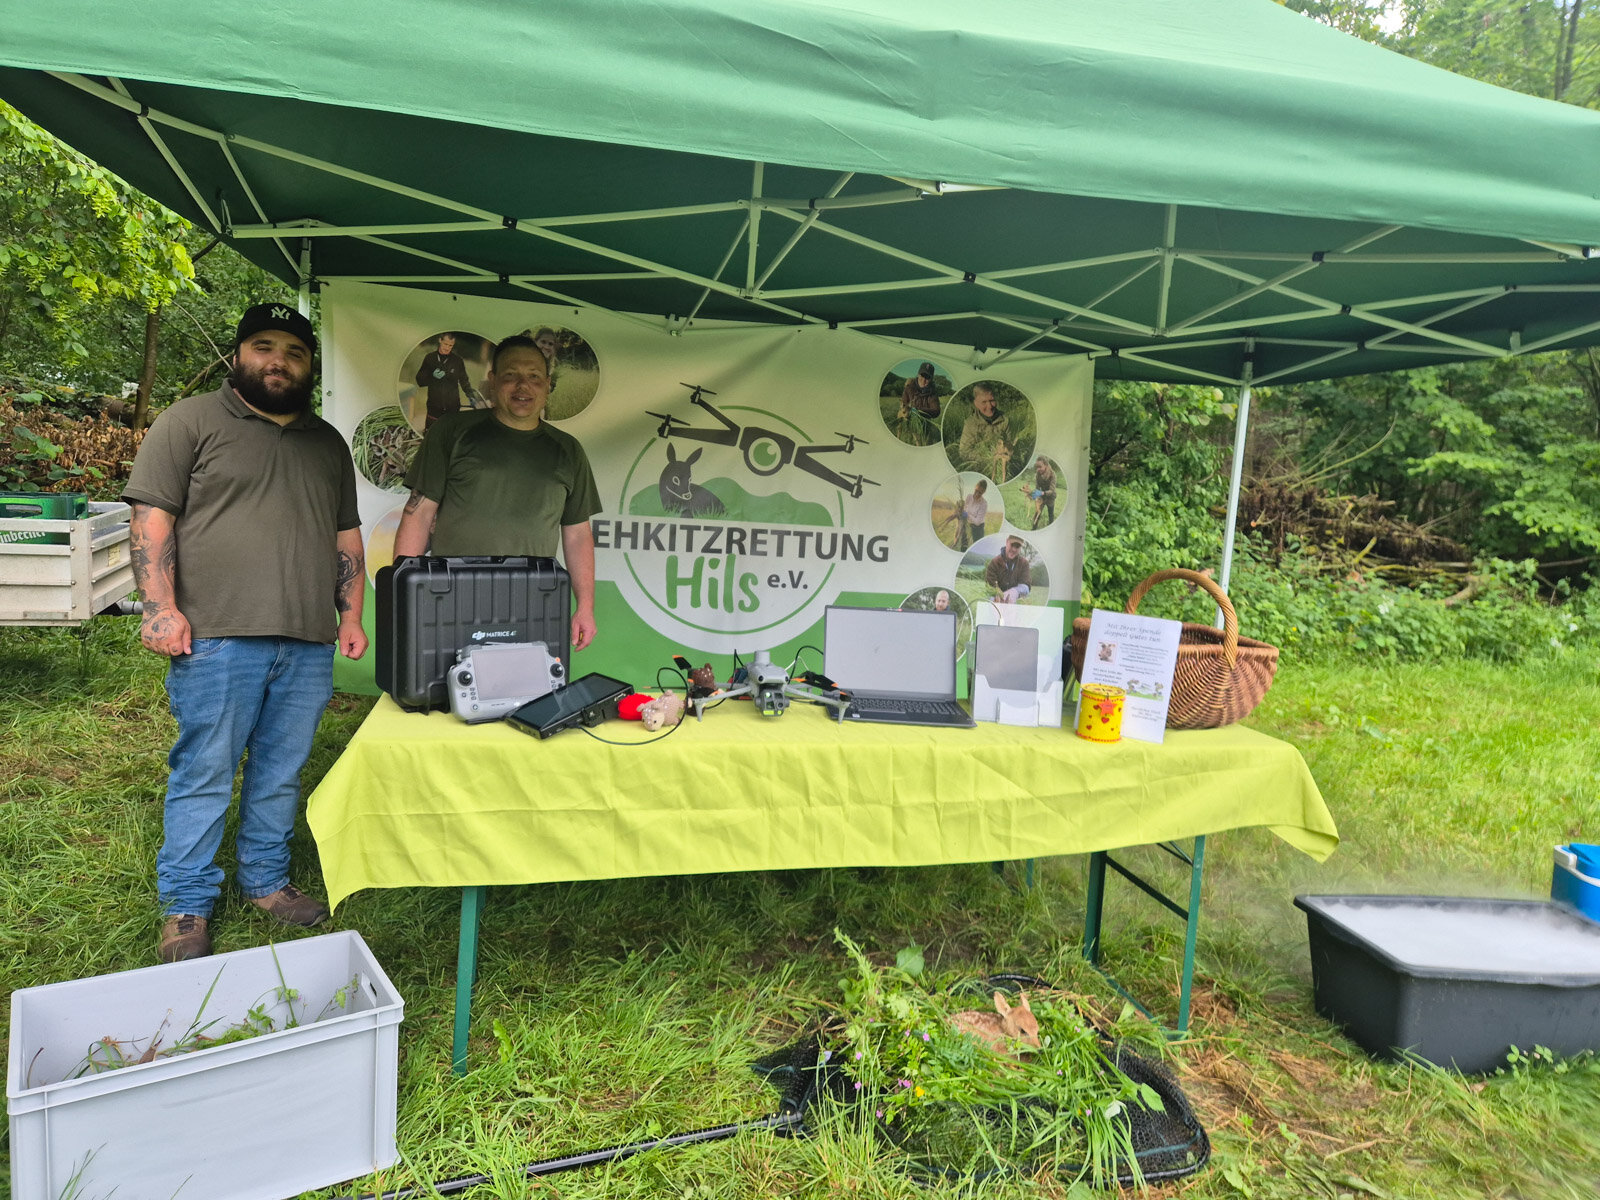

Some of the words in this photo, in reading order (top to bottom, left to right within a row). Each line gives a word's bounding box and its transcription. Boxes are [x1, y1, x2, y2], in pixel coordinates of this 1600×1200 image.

[271, 306, 290, 320] NY
[592, 520, 889, 562] EHKITZRETTUNG
[666, 553, 760, 613] Hils
[767, 570, 808, 589] e.V.
